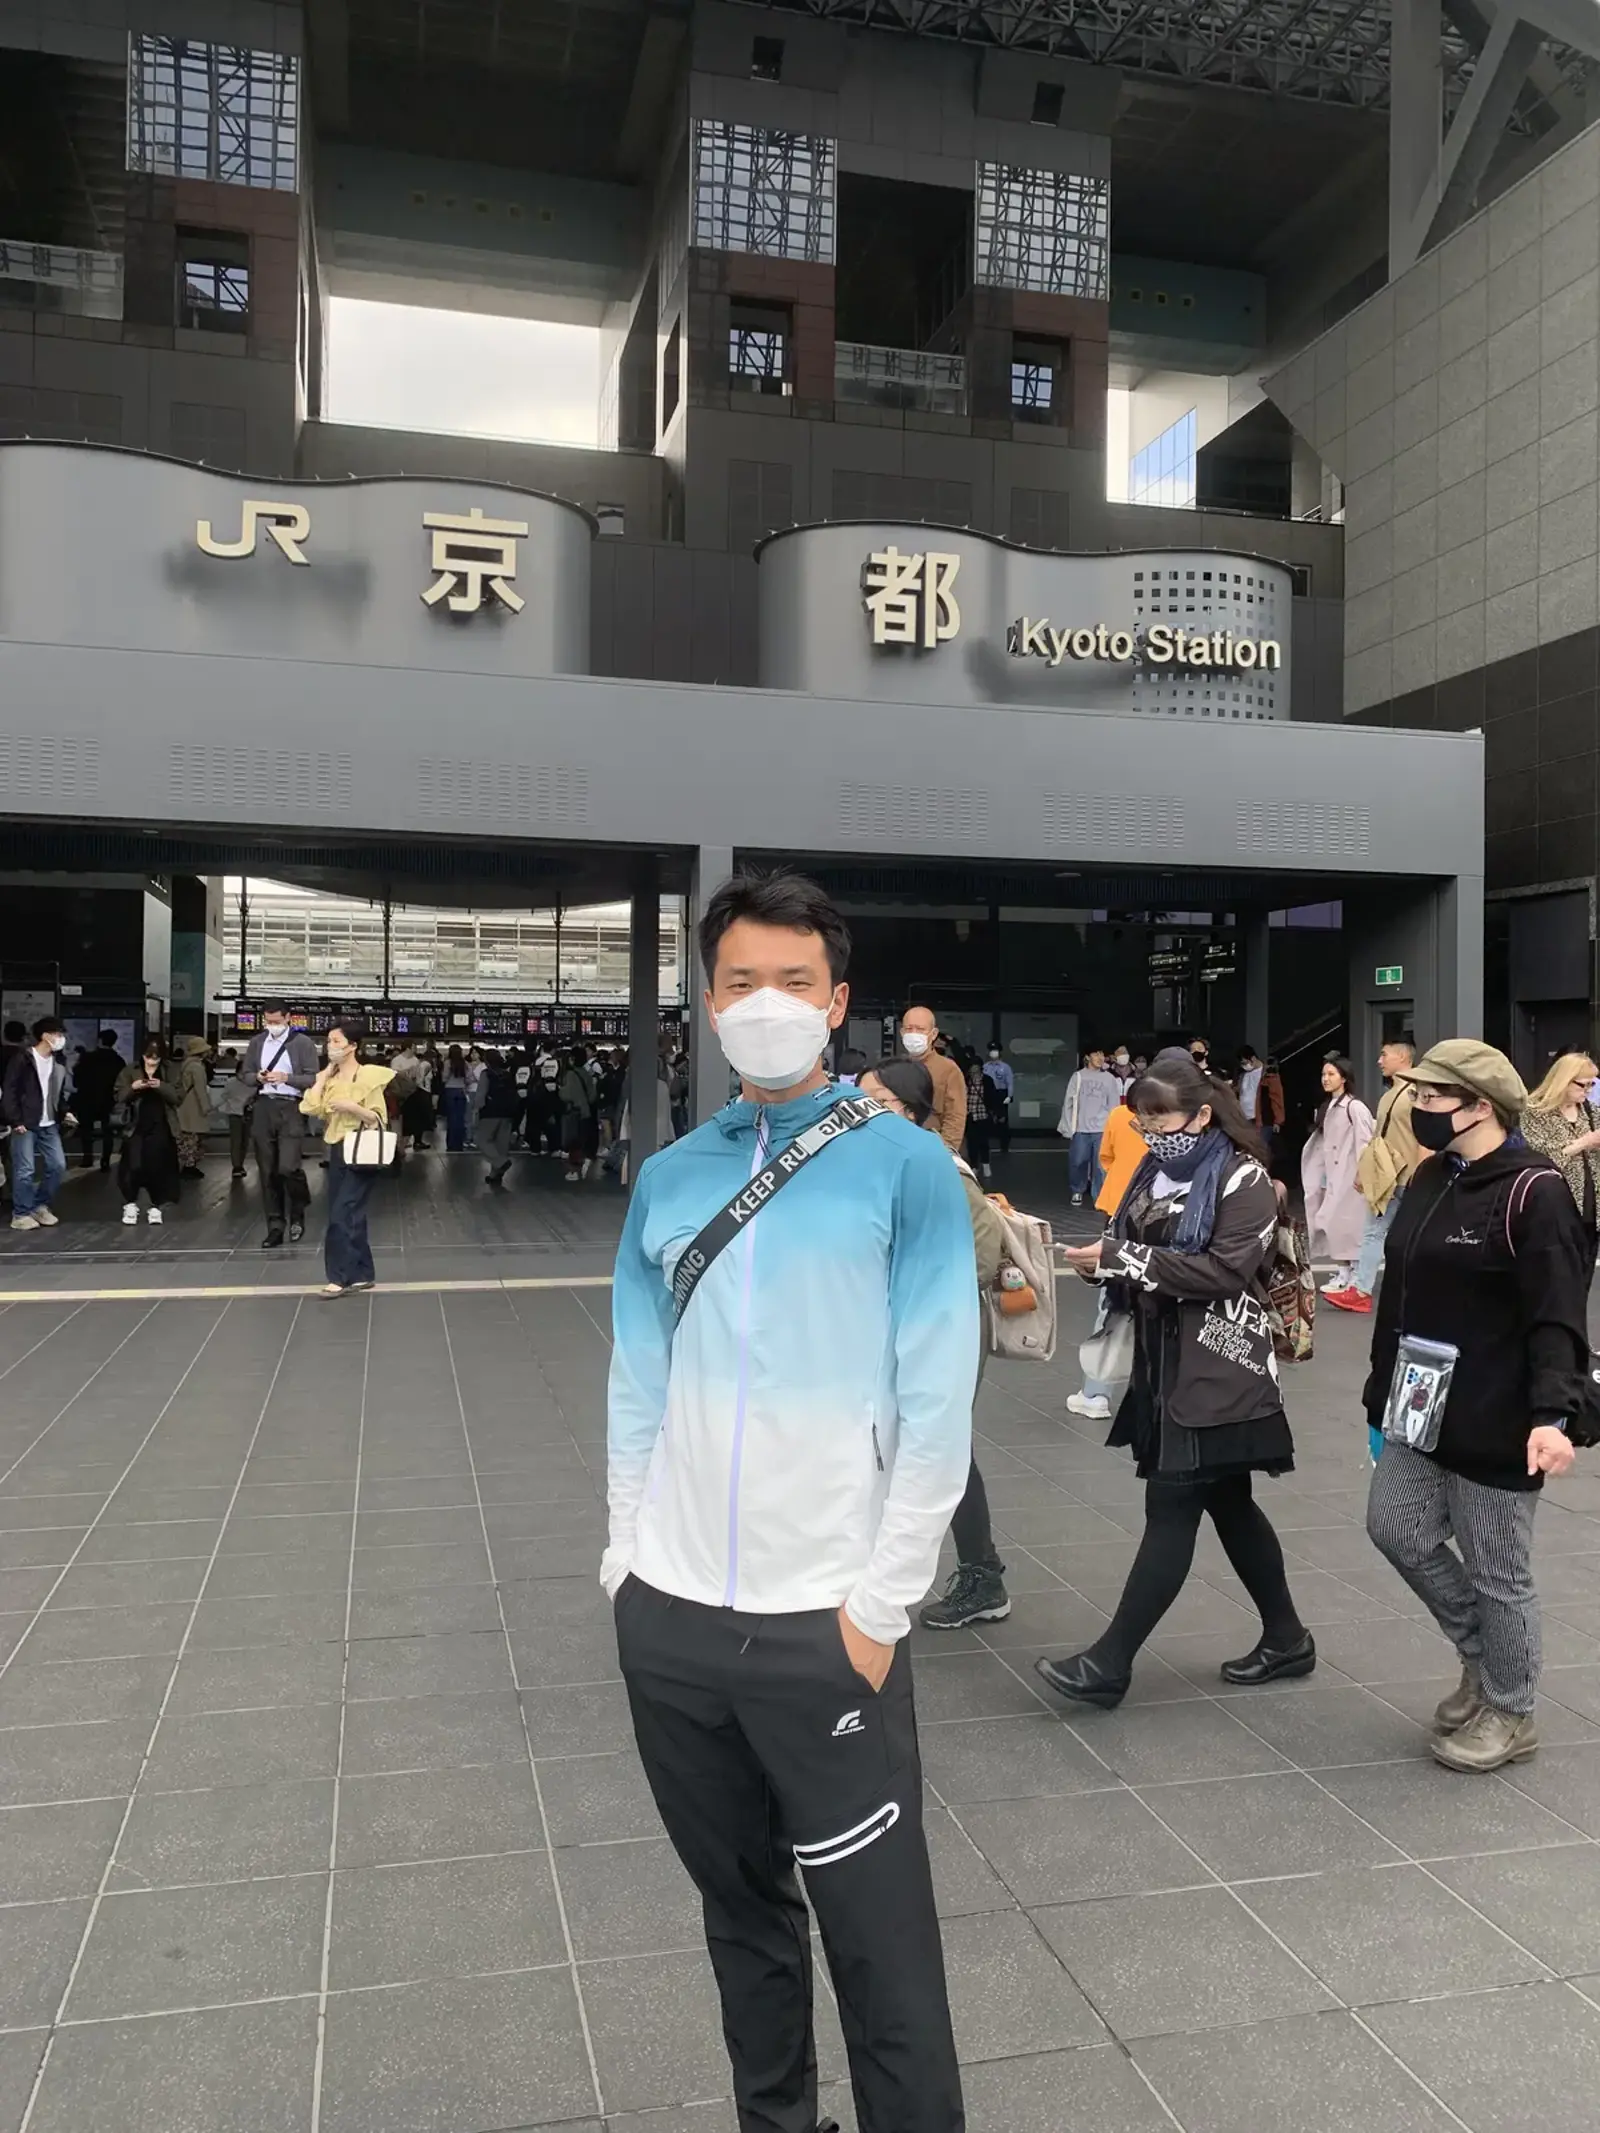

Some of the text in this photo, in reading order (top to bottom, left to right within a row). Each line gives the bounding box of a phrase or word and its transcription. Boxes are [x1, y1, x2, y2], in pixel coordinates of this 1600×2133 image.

[197, 500, 311, 566] JR
[419, 507, 529, 614] 京
[863, 545, 961, 650] 都
[1019, 614, 1283, 671] Kyoto Station
[728, 1171, 777, 1223] KEEP
[1220, 1347, 1238, 1362] THE
